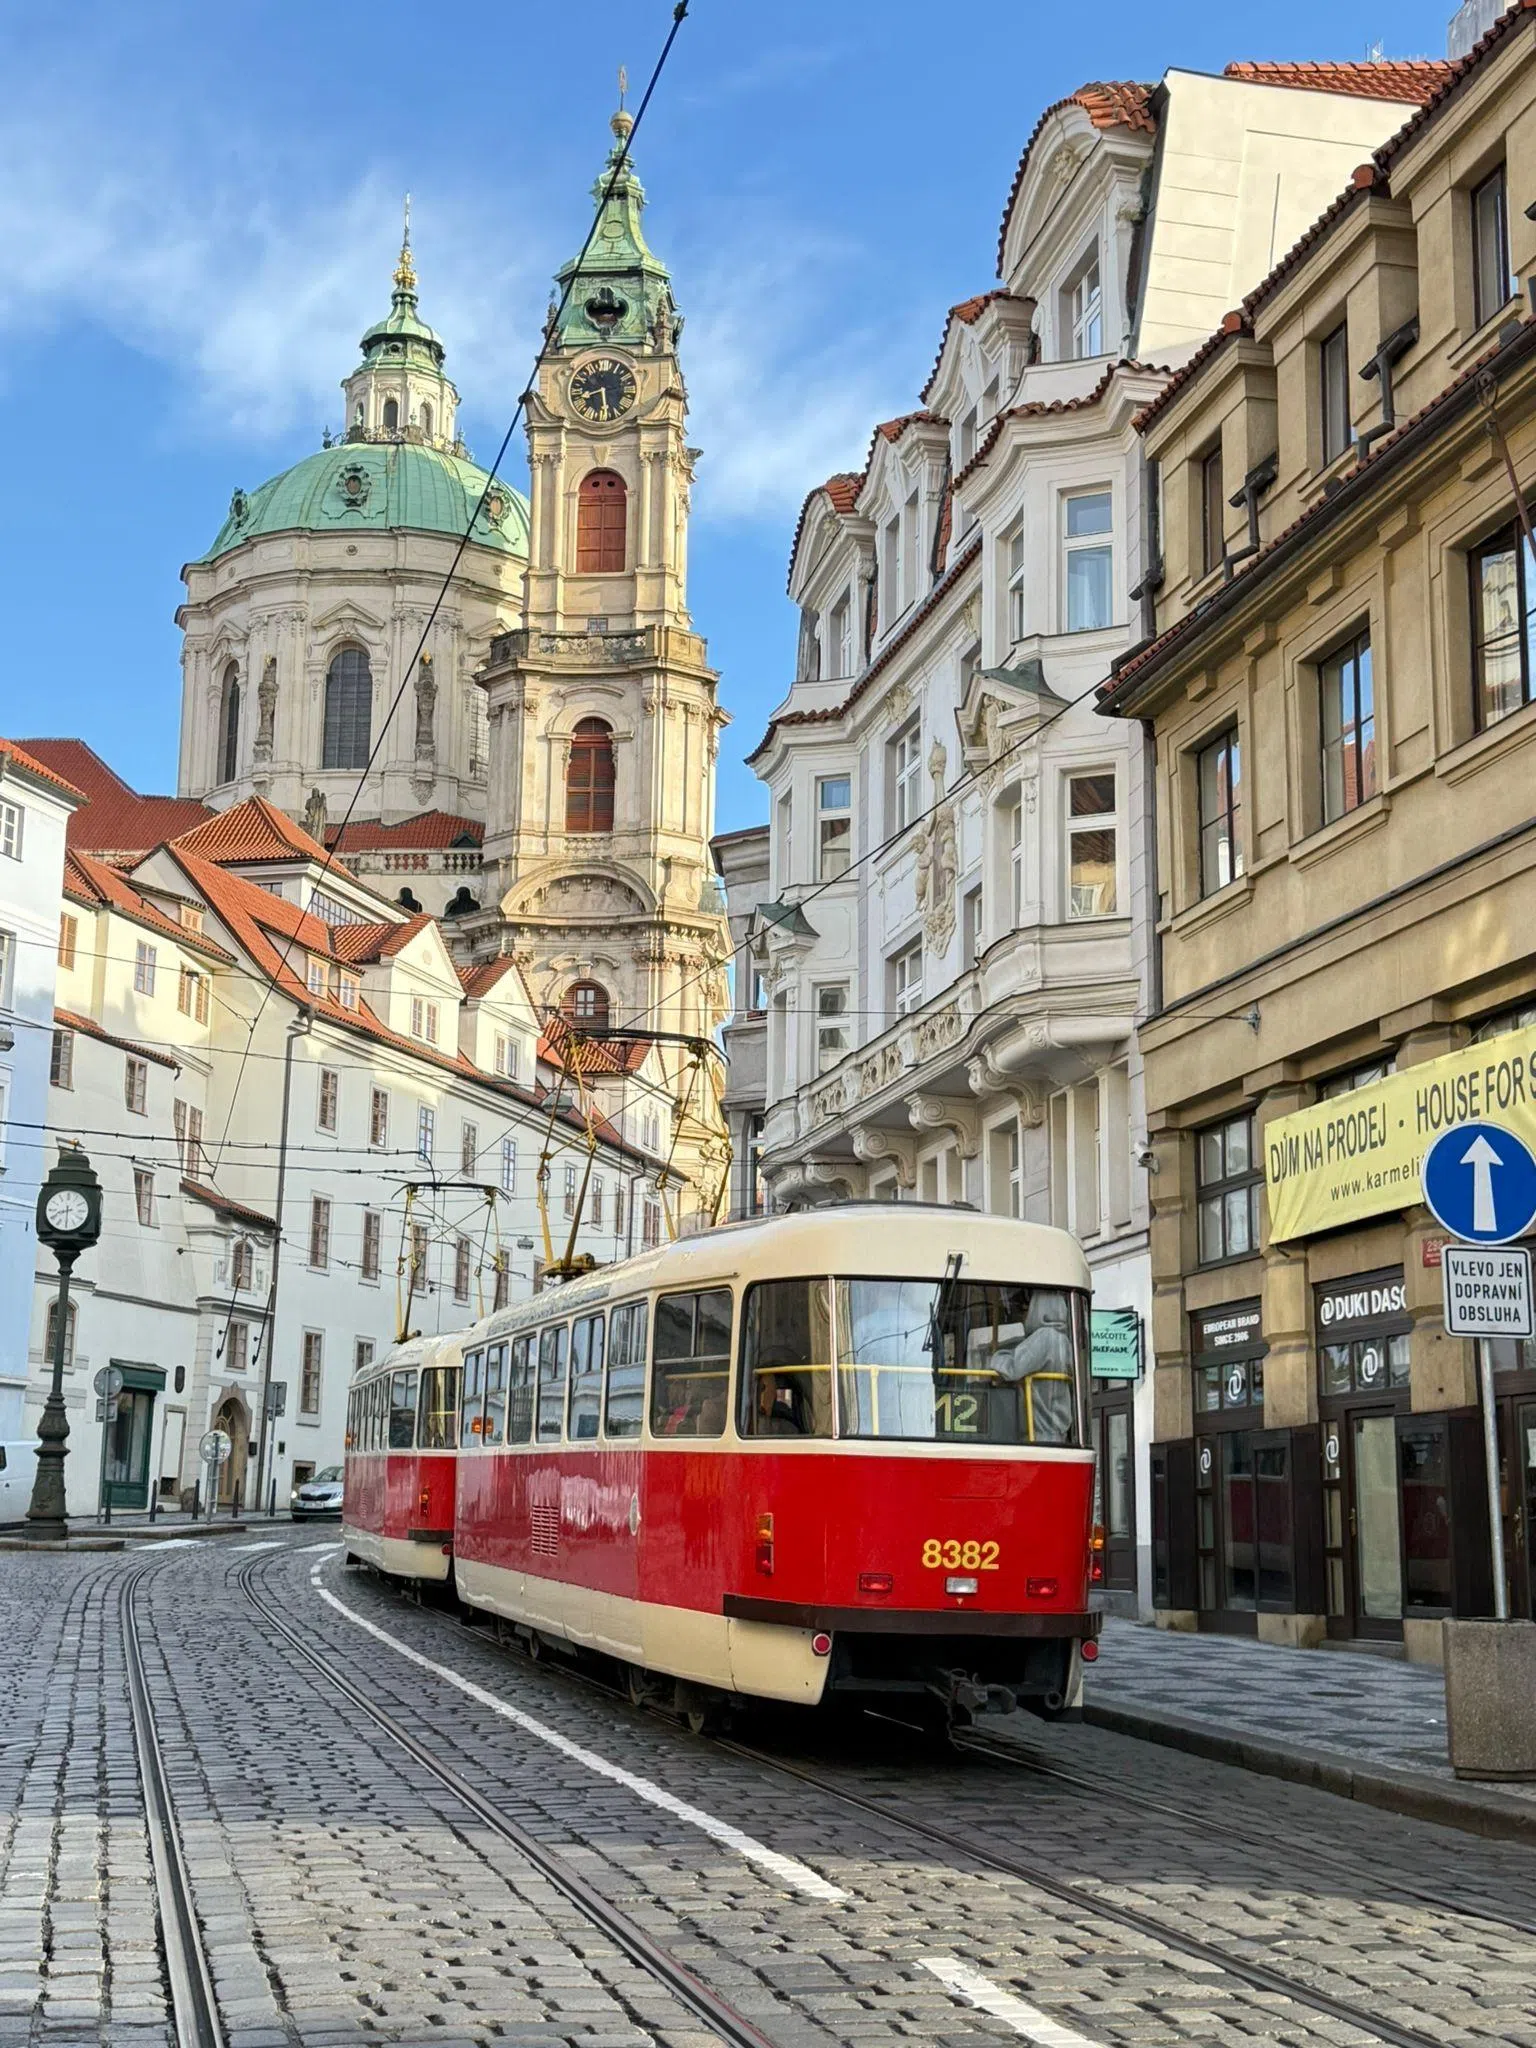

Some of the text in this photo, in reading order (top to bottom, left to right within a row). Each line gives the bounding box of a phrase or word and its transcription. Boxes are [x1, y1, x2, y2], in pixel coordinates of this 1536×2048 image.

[1304, 1127, 1323, 1173] NA
[1327, 1102, 1386, 1164] PRODEJ
[1417, 1070, 1480, 1134] HOUSE
[1486, 1056, 1525, 1114] FOR
[1331, 1154, 1424, 1201] www.karmeli
[1452, 1260, 1523, 1278] VLEVO JEN
[1455, 1281, 1522, 1301] DOPRAVNÍ
[1459, 1305, 1521, 1323] OBSLUHA
[936, 1393, 977, 1432] 12
[922, 1539, 999, 1570] 8382
